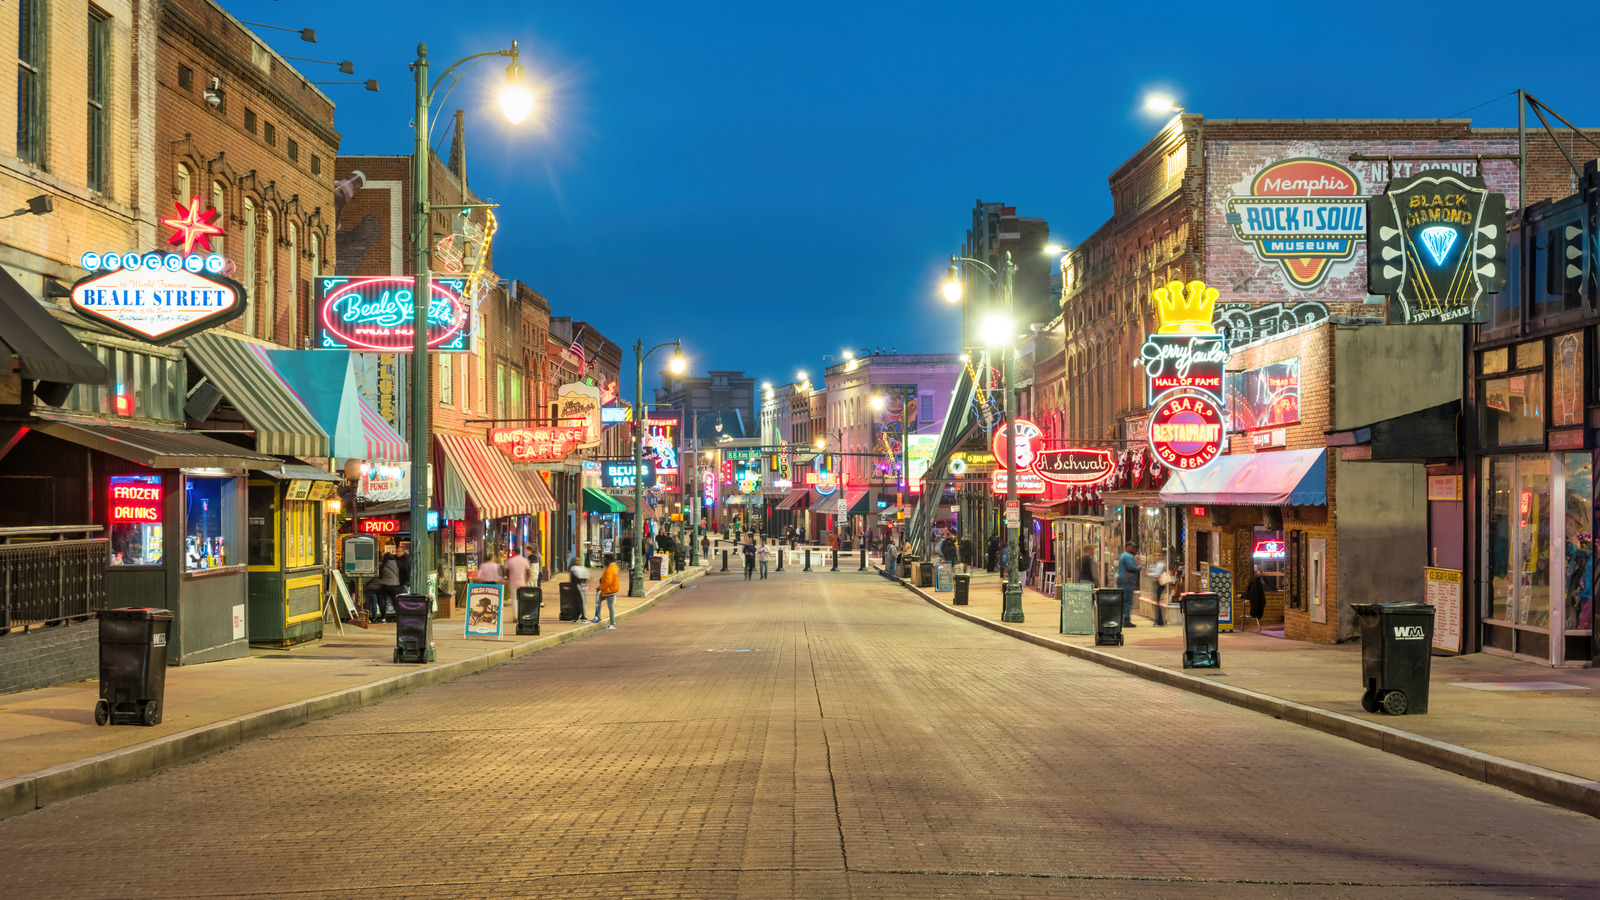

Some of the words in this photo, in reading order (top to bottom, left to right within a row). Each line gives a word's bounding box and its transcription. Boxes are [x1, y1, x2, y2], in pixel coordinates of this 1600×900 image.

[1371, 163, 1412, 182] NEXT
[1264, 175, 1349, 196] Memphis
[1409, 194, 1467, 208] BLACK
[1246, 206, 1300, 231] ROCK
[1303, 209, 1313, 227] n
[1315, 206, 1364, 231] SOUL
[1405, 208, 1472, 229] DIAMOND
[82, 252, 225, 273] WELCOME
[84, 289, 145, 306] BEALE
[153, 289, 225, 306] STREET
[332, 290, 399, 322] Beale
[1412, 307, 1442, 323] JEWEL
[1440, 306, 1470, 323] BEALE
[1155, 378, 1178, 387] HALL
[1180, 378, 1192, 386] OF
[1195, 378, 1220, 386] FAME
[1170, 397, 1204, 412] BAR
[534, 430, 582, 442] PALACE
[1153, 423, 1221, 442] RESTAURANT
[513, 444, 563, 458] CAFE
[1158, 445, 1176, 463] 159
[1180, 445, 1217, 468] BEALE
[1054, 453, 1110, 470] Schwab
[113, 486, 160, 501] FROZEN
[369, 481, 389, 491] PUNCH
[114, 505, 158, 520] DRINKS
[365, 521, 395, 532] PATIO
[471, 587, 485, 595] FRESH
[485, 587, 499, 595] FUDGE
[1394, 625, 1425, 637] WM
